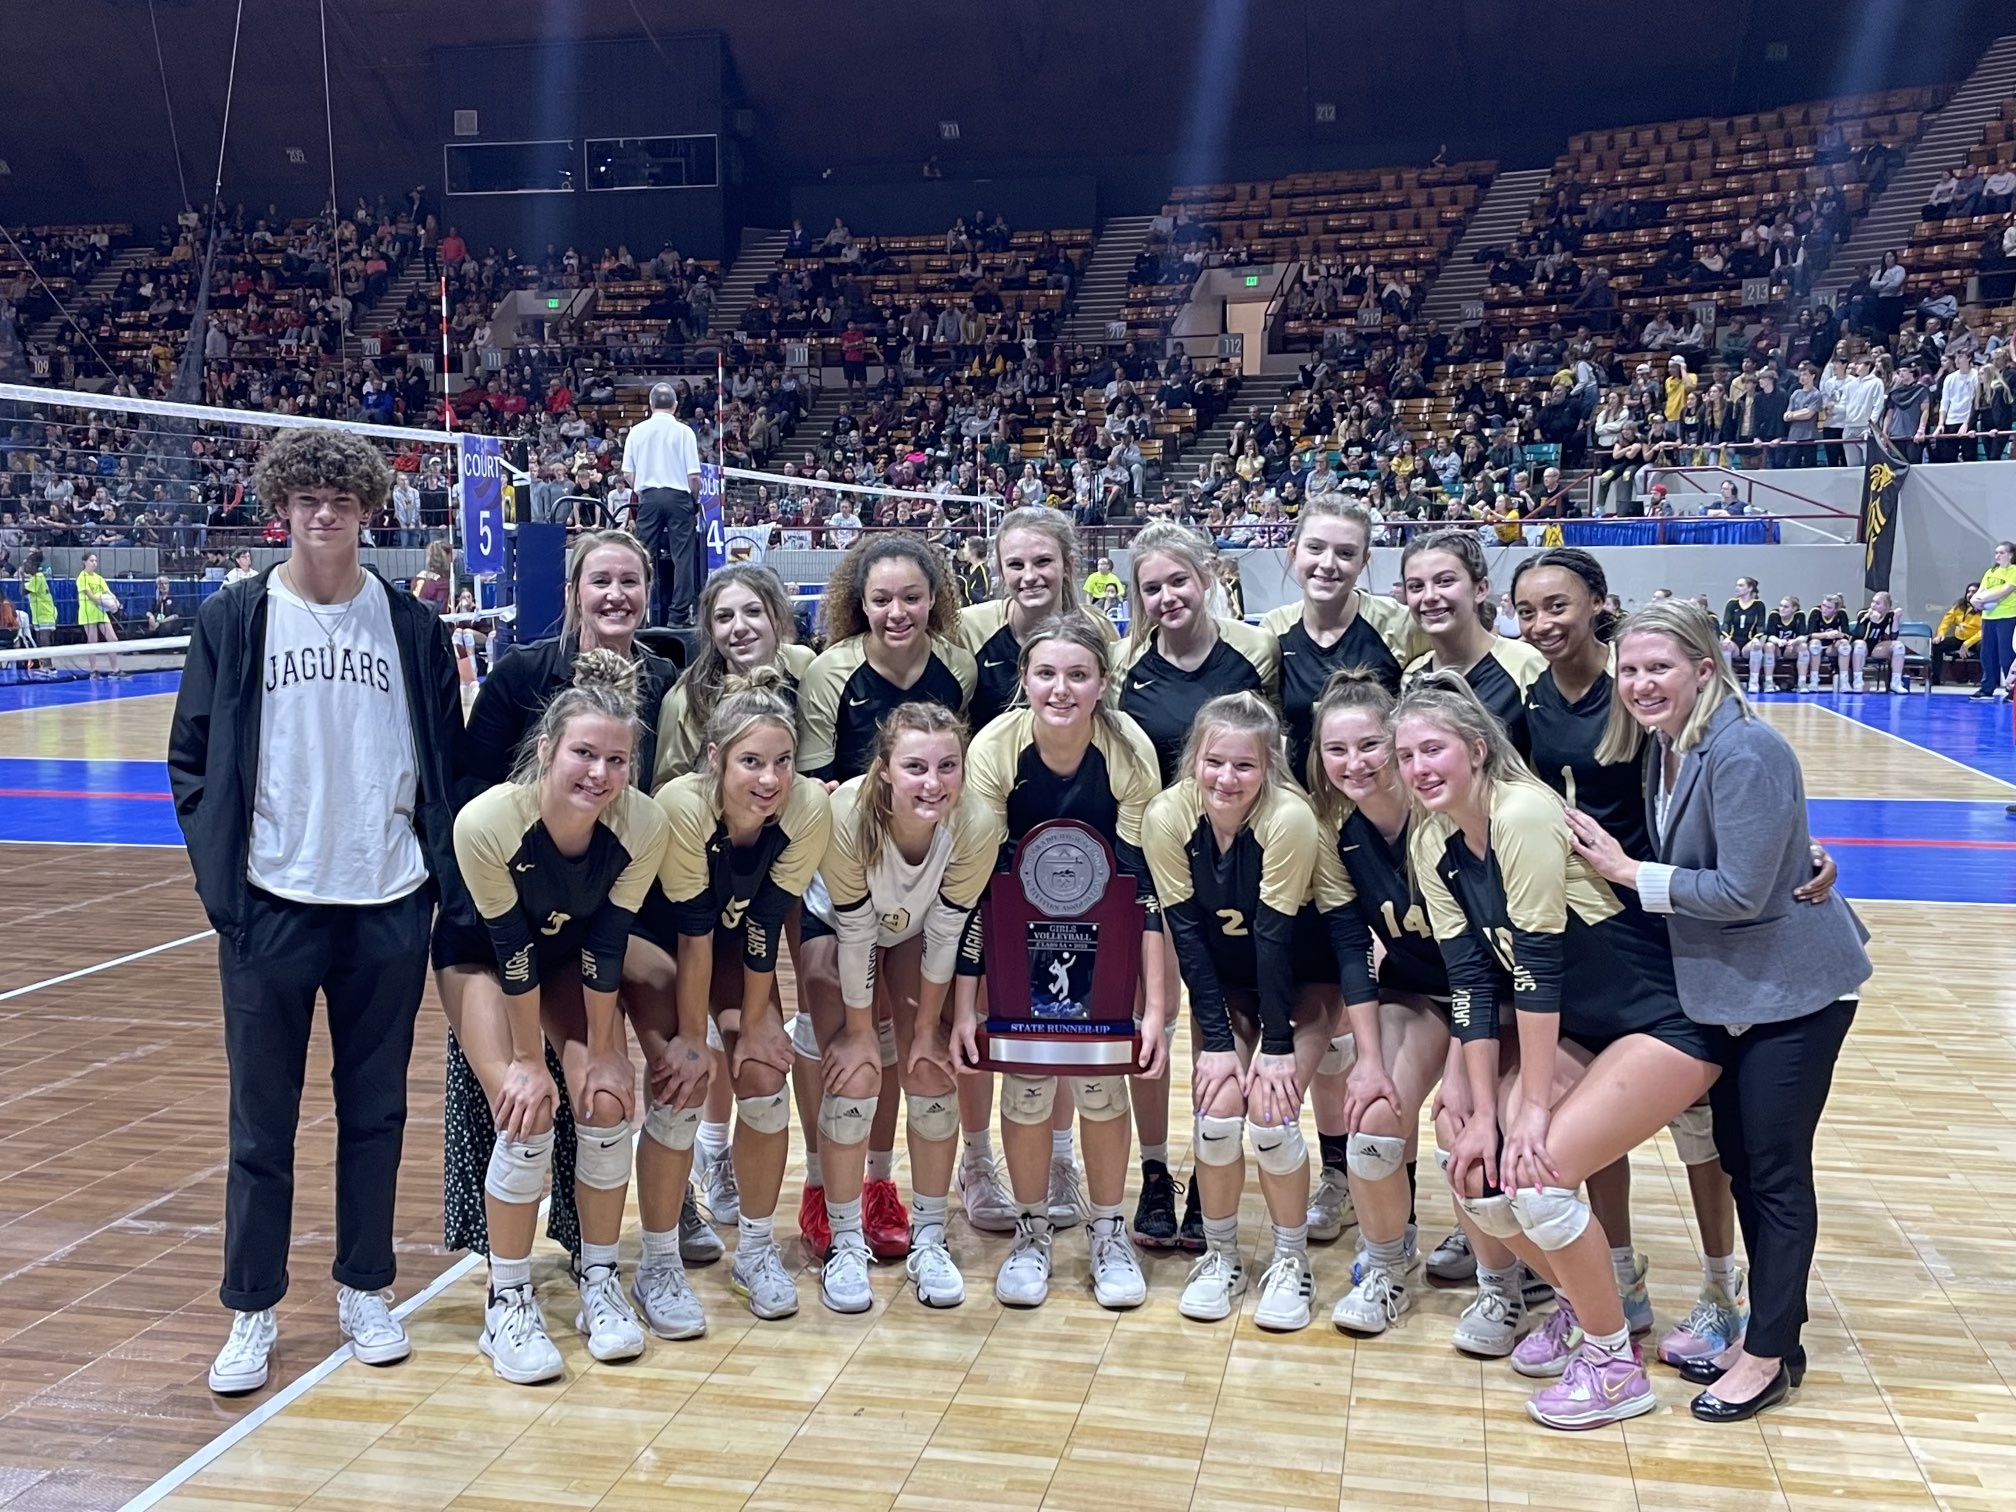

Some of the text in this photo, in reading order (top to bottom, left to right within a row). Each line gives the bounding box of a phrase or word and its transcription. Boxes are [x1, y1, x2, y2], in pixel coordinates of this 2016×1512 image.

[942, 123, 960, 137] 211
[1748, 283, 1769, 301] 213
[1363, 313, 1381, 326] 212
[1108, 326, 1126, 340] 212
[279, 343, 298, 357] 29
[364, 341, 382, 355] 210
[1225, 338, 1242, 354] 112
[487, 352, 501, 367] 111
[795, 348, 809, 364] 111
[33, 360, 49, 374] 109
[464, 453, 500, 478] COURT
[479, 510, 492, 556] 5
[707, 519, 725, 555] 4
[1738, 614, 1746, 629] 1
[265, 646, 390, 693] JAGUARS
[1215, 908, 1249, 936] 2
[1380, 900, 1432, 939] 14
[1033, 931, 1092, 941] VOLLEYBALL
[1049, 924, 1078, 934] GIRLS
[1010, 1023, 1111, 1035] STATE RUNNER-UP
